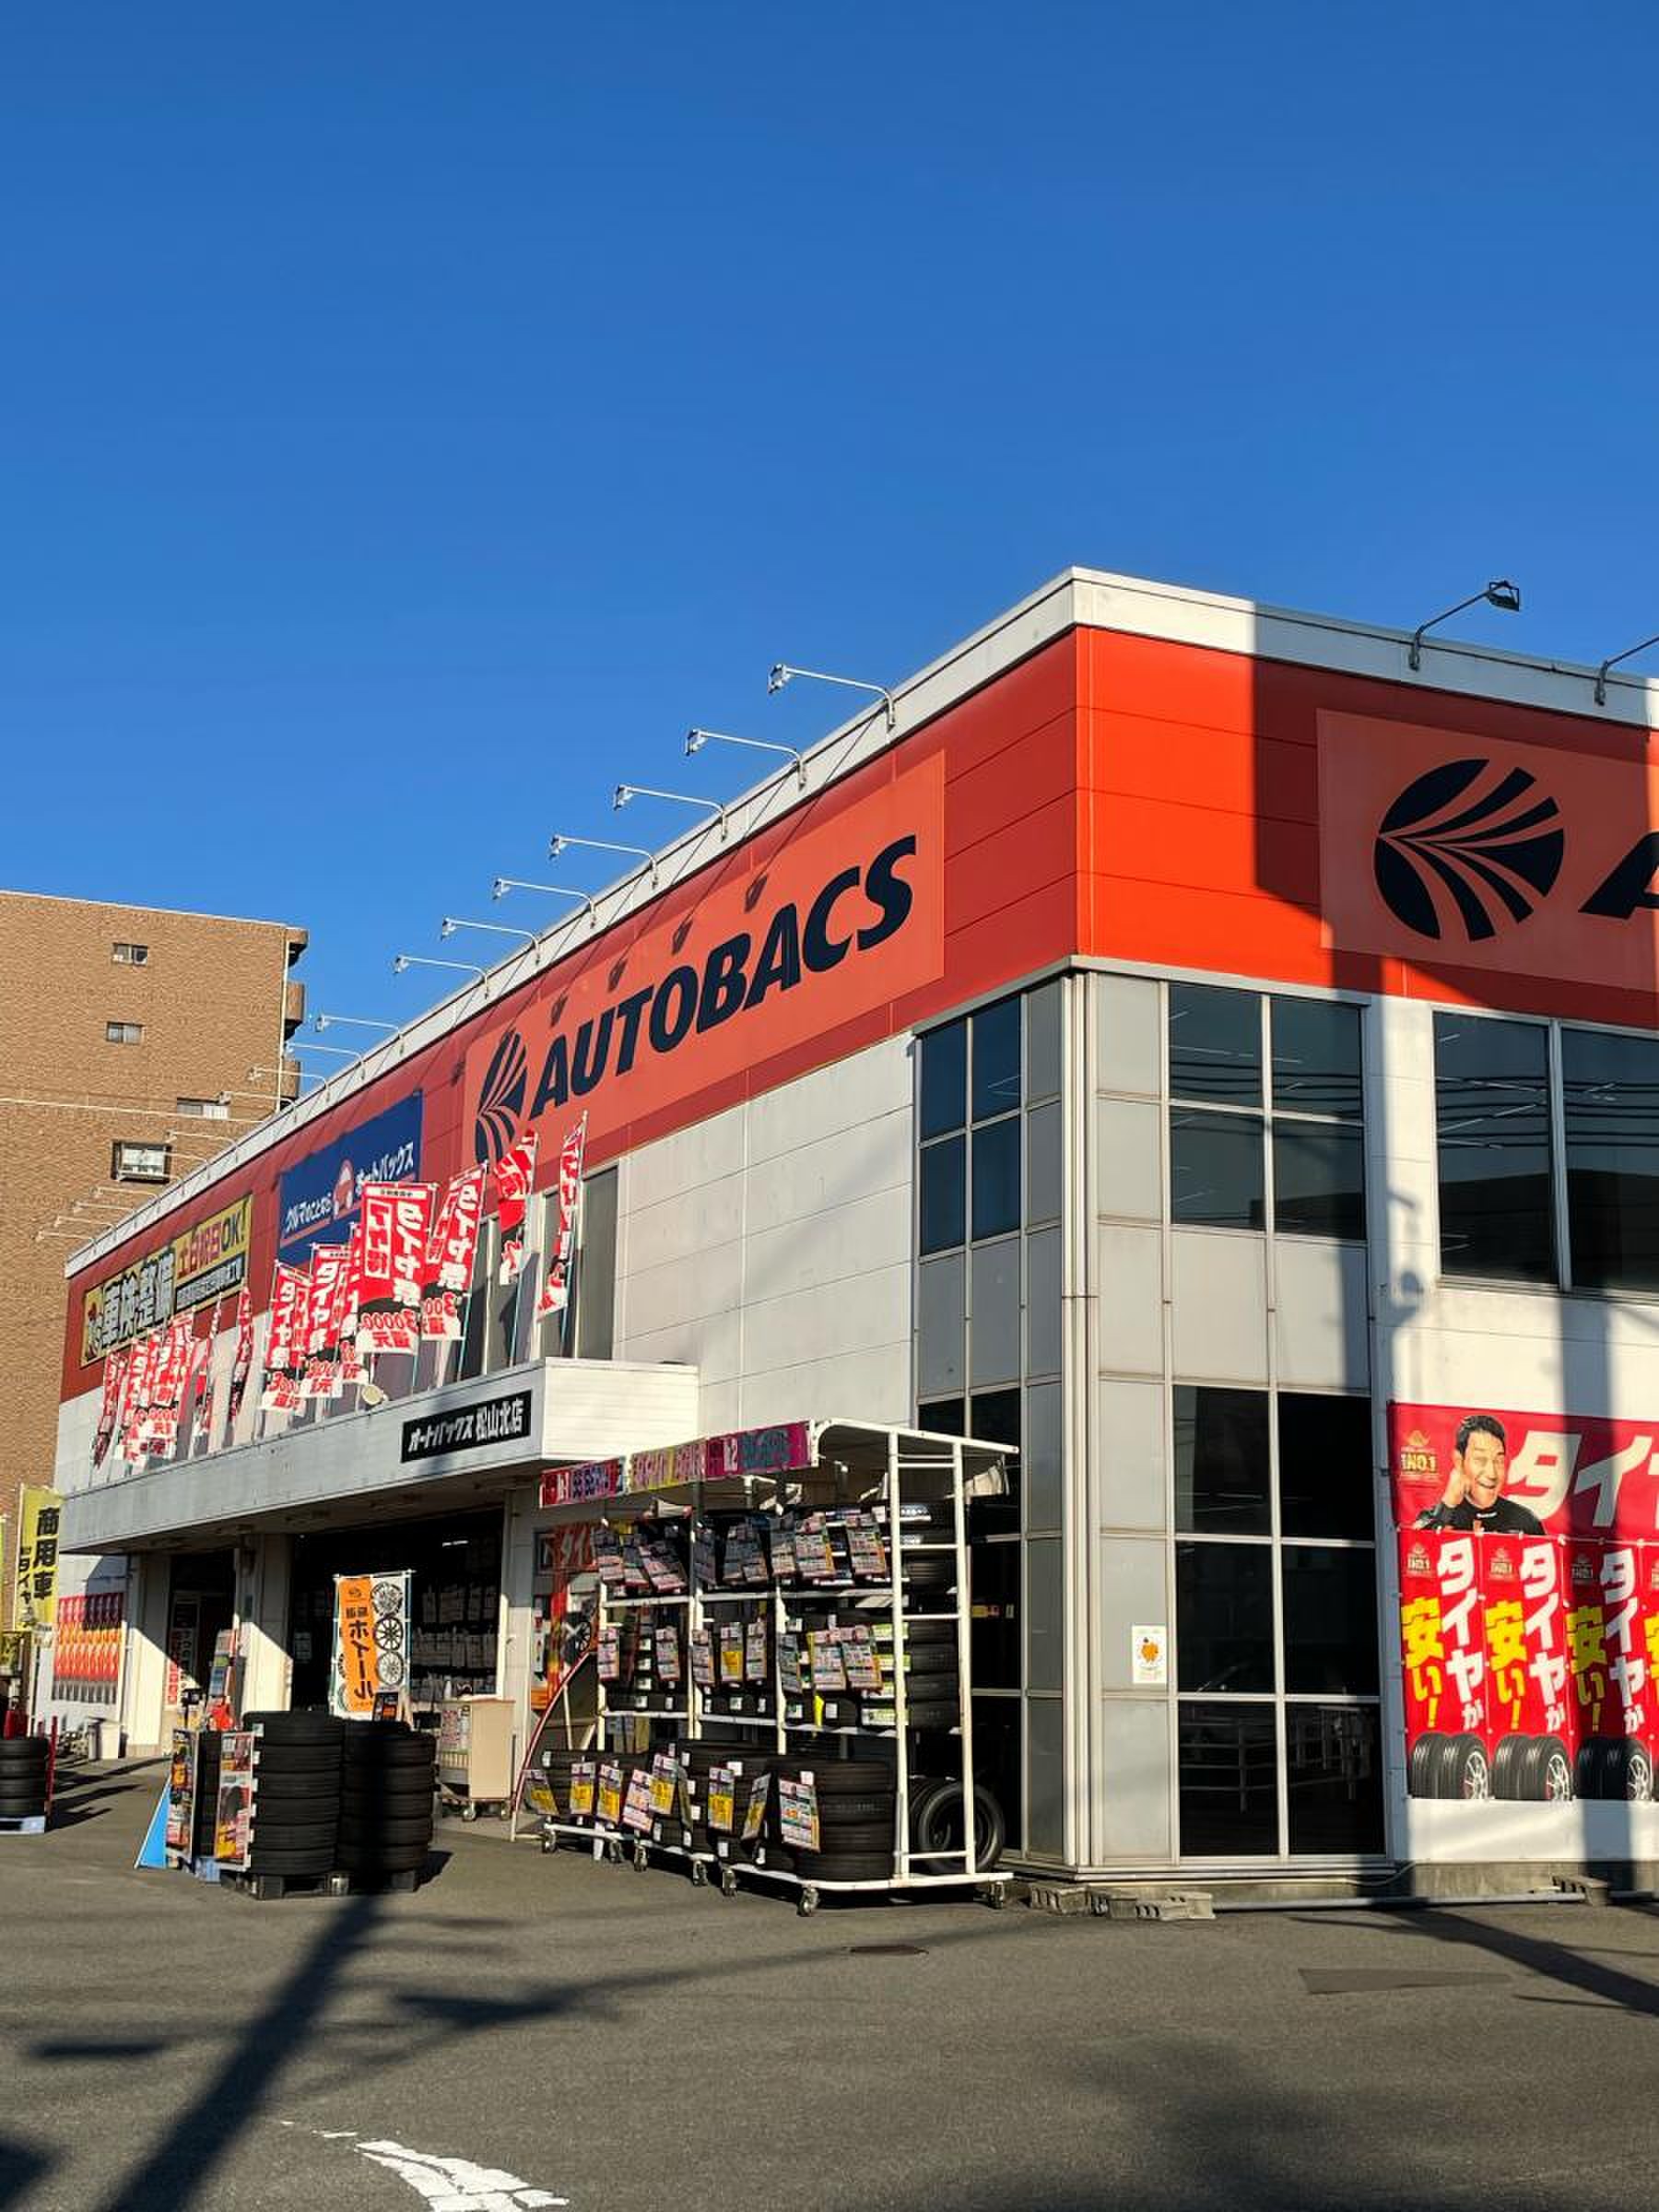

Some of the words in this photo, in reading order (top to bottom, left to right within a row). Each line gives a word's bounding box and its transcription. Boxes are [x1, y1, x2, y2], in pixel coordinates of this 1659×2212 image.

[529, 834, 917, 1121] AUTOBACS
[407, 1415, 474, 1453] オートバックス
[1507, 1430, 1659, 1527] タイ
[32, 1506, 60, 1600] 商用車
[1437, 1536, 1484, 1731] タイヤが
[1520, 1542, 1566, 1734] タイヤが
[1600, 1548, 1644, 1735] タイヤが
